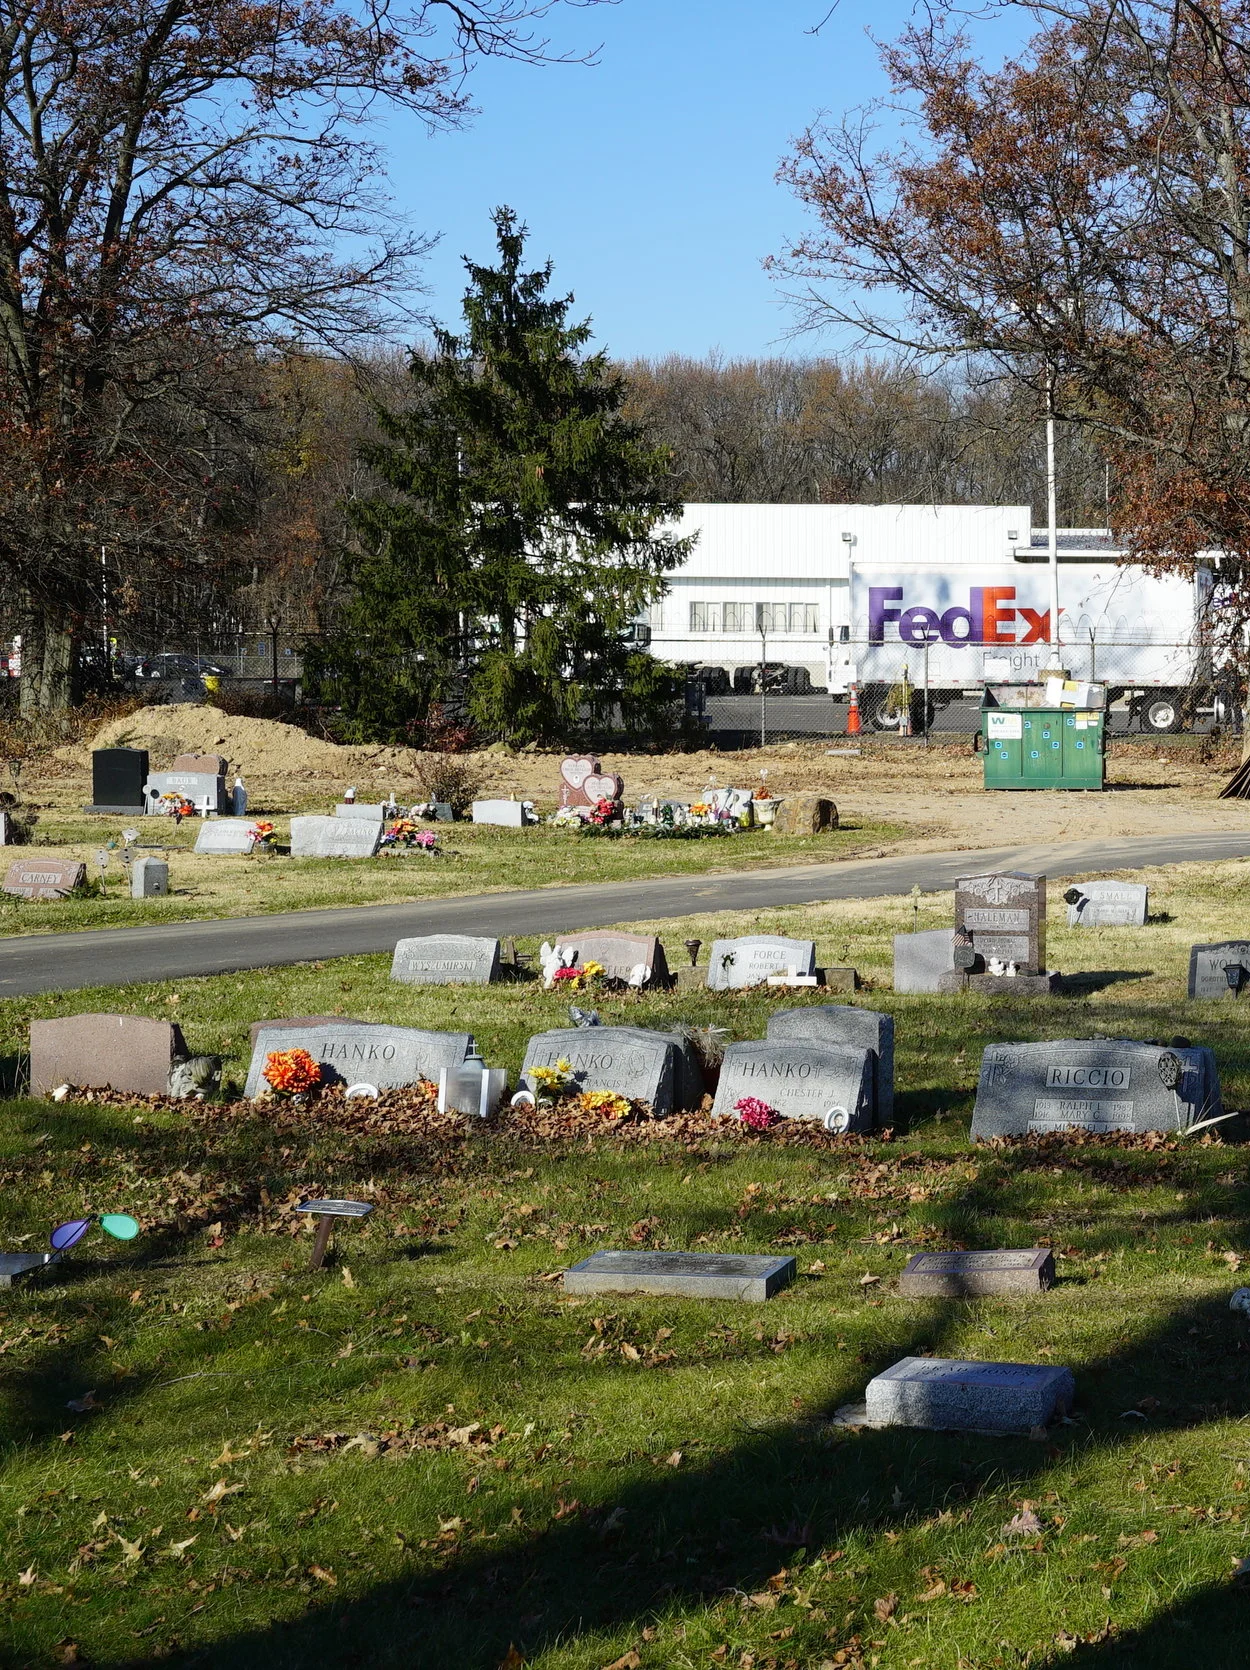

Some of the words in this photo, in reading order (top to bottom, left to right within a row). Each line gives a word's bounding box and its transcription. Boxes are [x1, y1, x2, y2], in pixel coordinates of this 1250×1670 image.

[868, 586, 1066, 649] FedEx
[982, 651, 1040, 671] Fight
[21, 873, 58, 884] CARNEY
[753, 950, 787, 960] FORCE
[748, 962, 778, 970] ROBERT
[321, 1042, 396, 1061] HANKO
[742, 1061, 812, 1079] HANKO
[1051, 1068, 1125, 1086] RICCIO
[583, 1078, 621, 1089] RANCIS
[779, 1087, 823, 1098] CHESTER
[1059, 1101, 1092, 1111] RALPH
[1060, 1111, 1087, 1119] MARY
